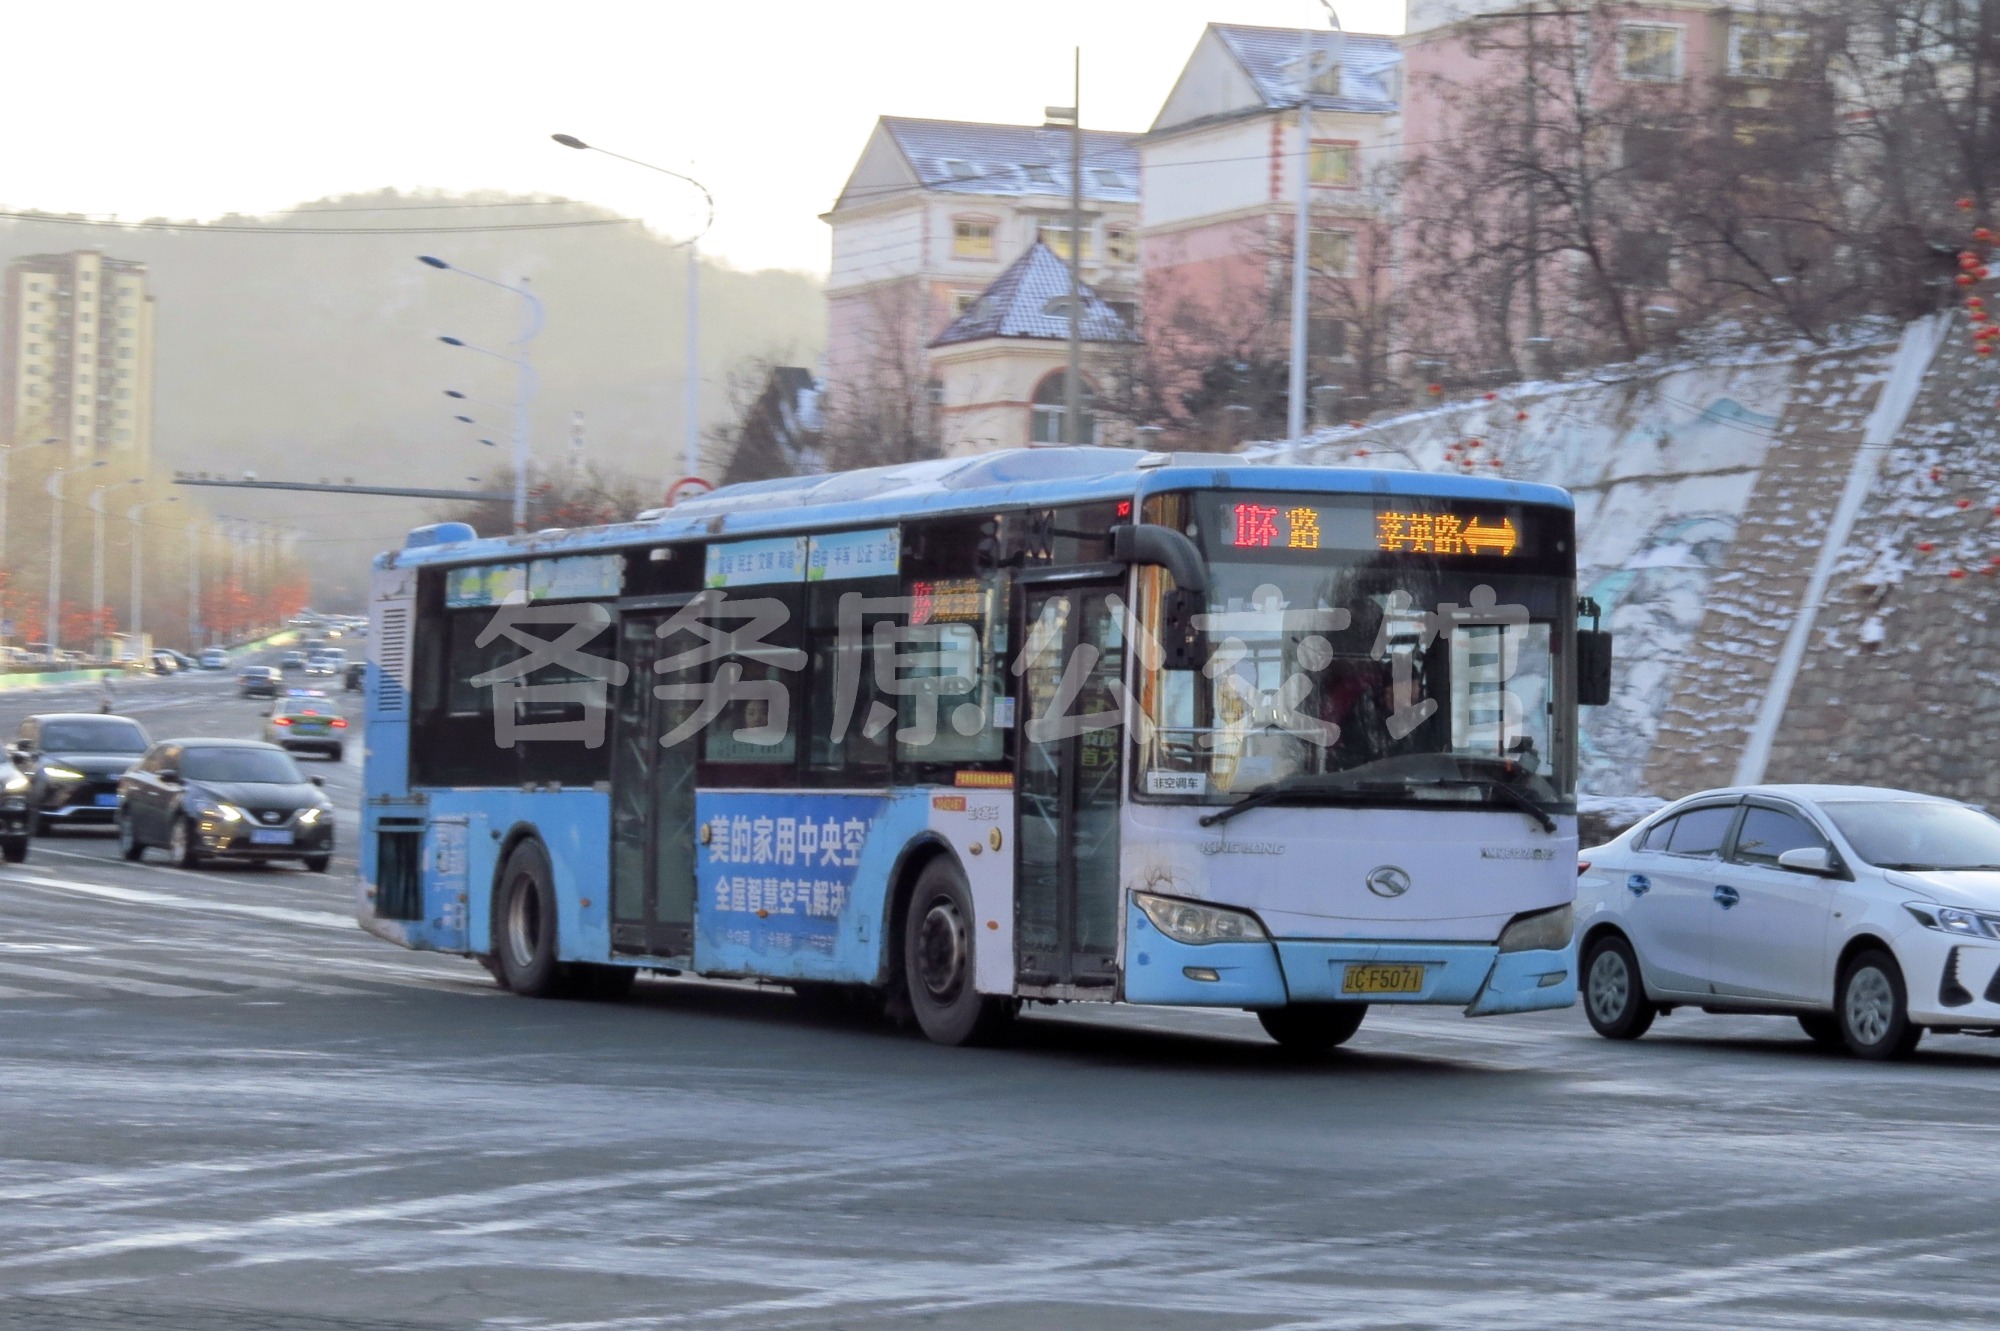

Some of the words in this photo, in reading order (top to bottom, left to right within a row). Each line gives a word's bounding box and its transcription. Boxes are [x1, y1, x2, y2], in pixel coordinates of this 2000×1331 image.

[1153, 777, 1199, 790] 非空调车
[709, 815, 872, 867] 美的家用中央空
